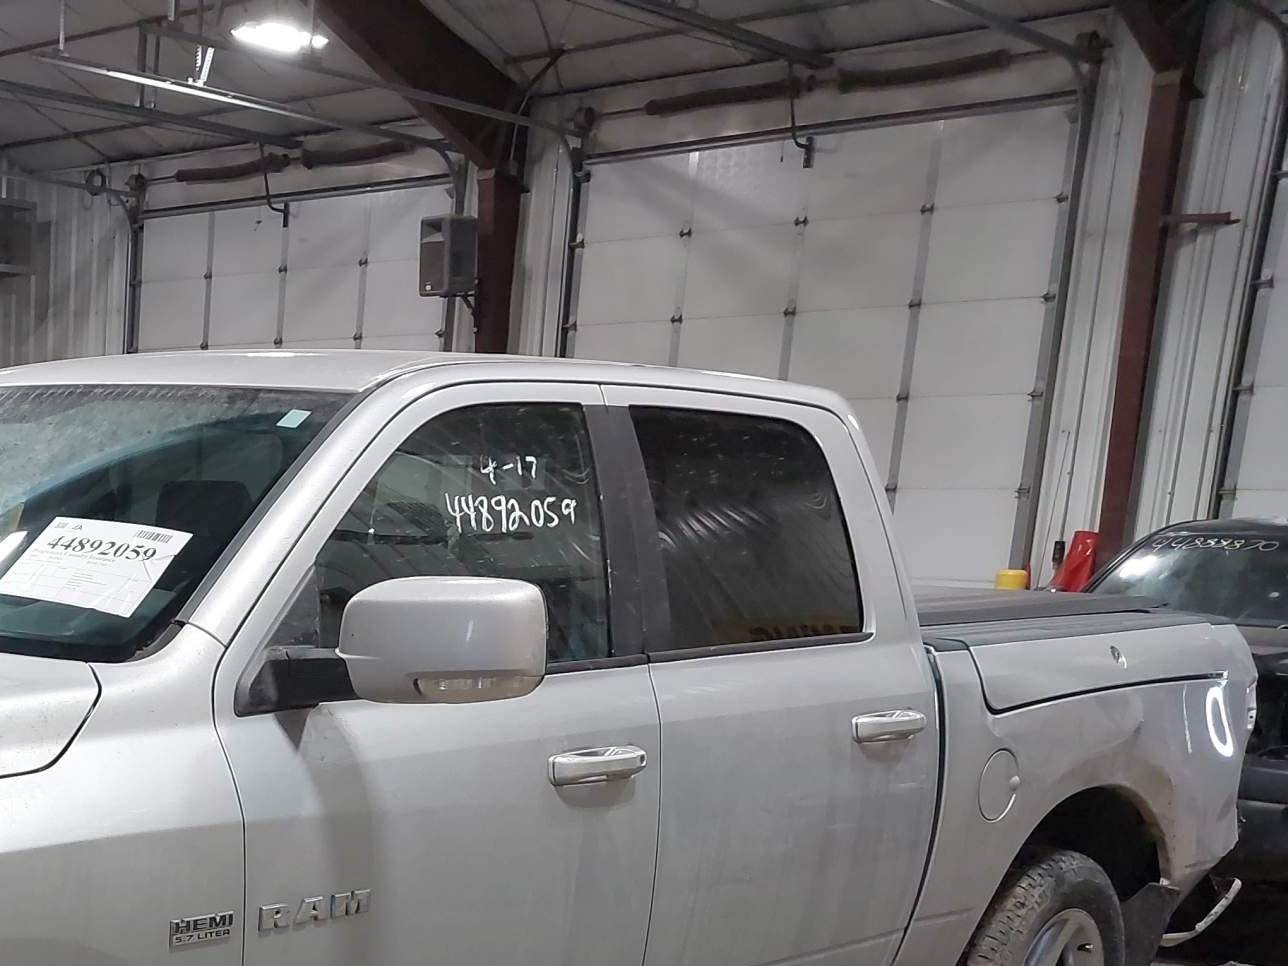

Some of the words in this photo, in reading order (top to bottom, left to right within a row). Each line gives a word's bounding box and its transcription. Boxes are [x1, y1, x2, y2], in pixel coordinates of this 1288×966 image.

[480, 454, 537, 485] 4-17
[444, 493, 577, 533] 44892059
[48, 535, 157, 561] 44892059
[172, 911, 234, 935] HEMI
[258, 889, 371, 932] RAM
[175, 933, 195, 944] 5.7
[197, 928, 231, 940] LITER
